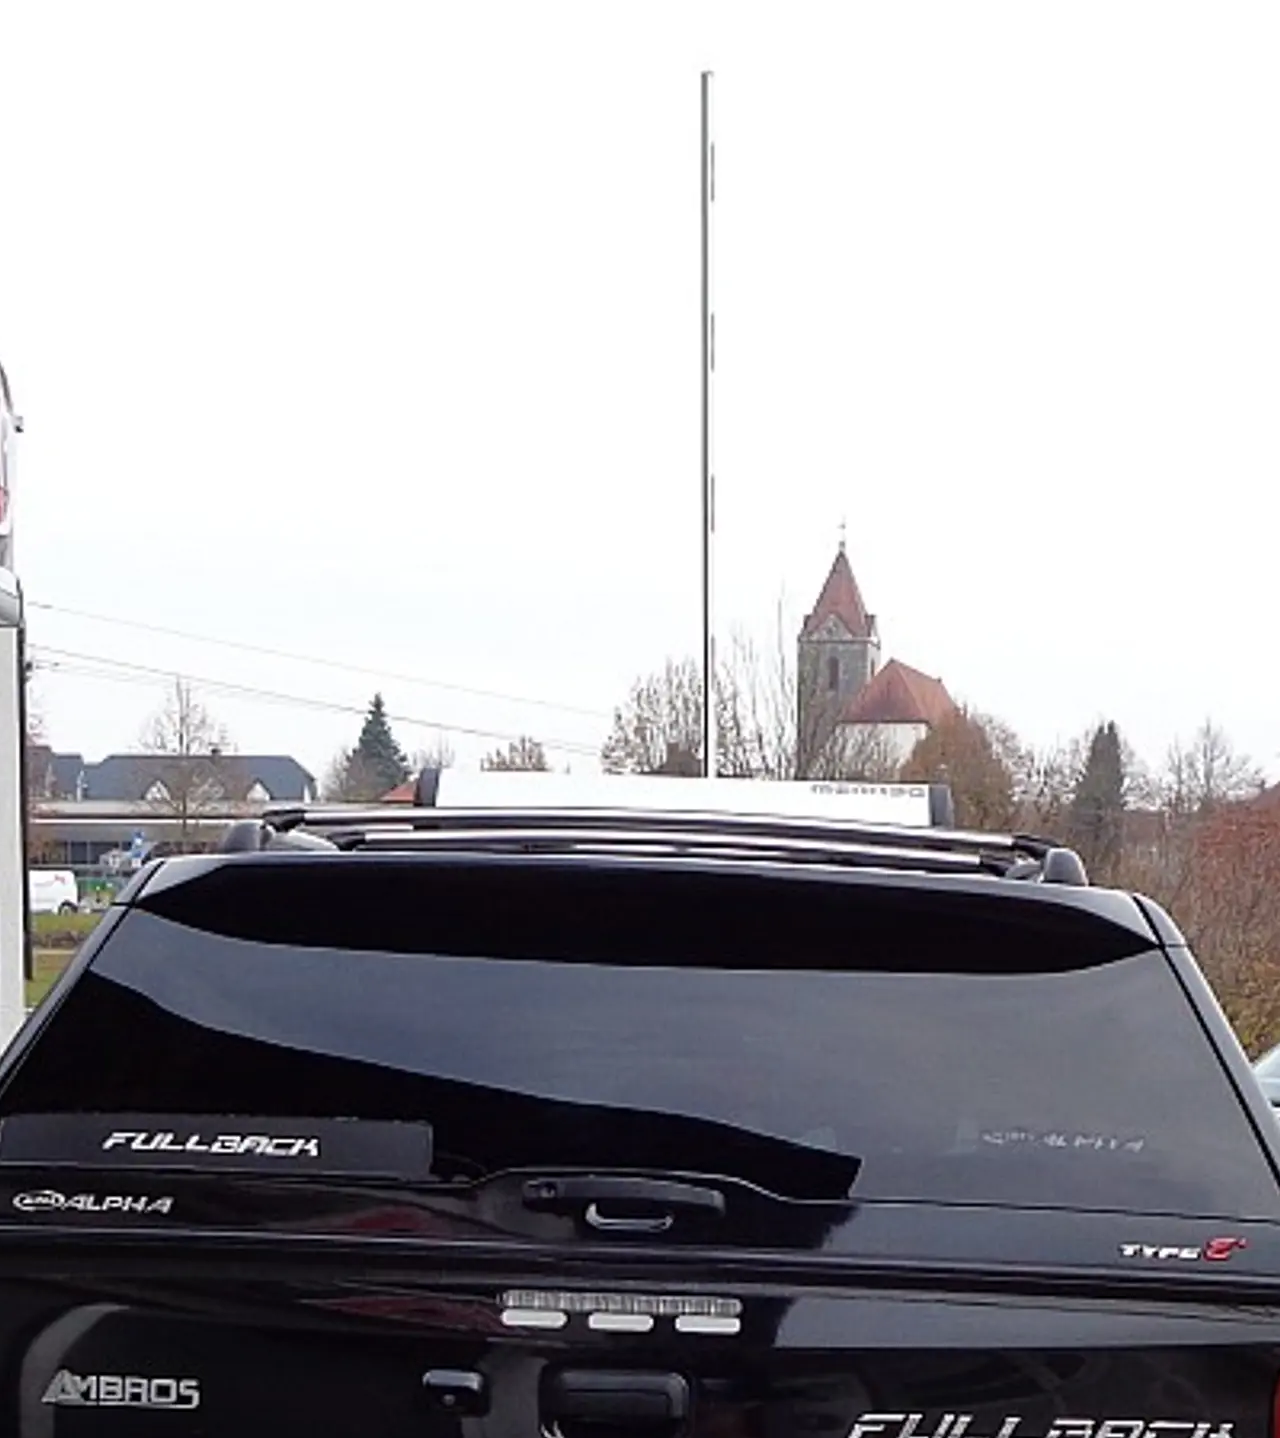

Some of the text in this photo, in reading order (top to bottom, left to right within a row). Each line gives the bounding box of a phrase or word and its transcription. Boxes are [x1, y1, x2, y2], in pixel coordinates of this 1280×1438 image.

[102, 1131, 319, 1157] FULLBACK
[65, 1194, 174, 1214] ALPHA
[1119, 1244, 1200, 1259] TYPE
[41, 1369, 200, 1409] AMBROS
